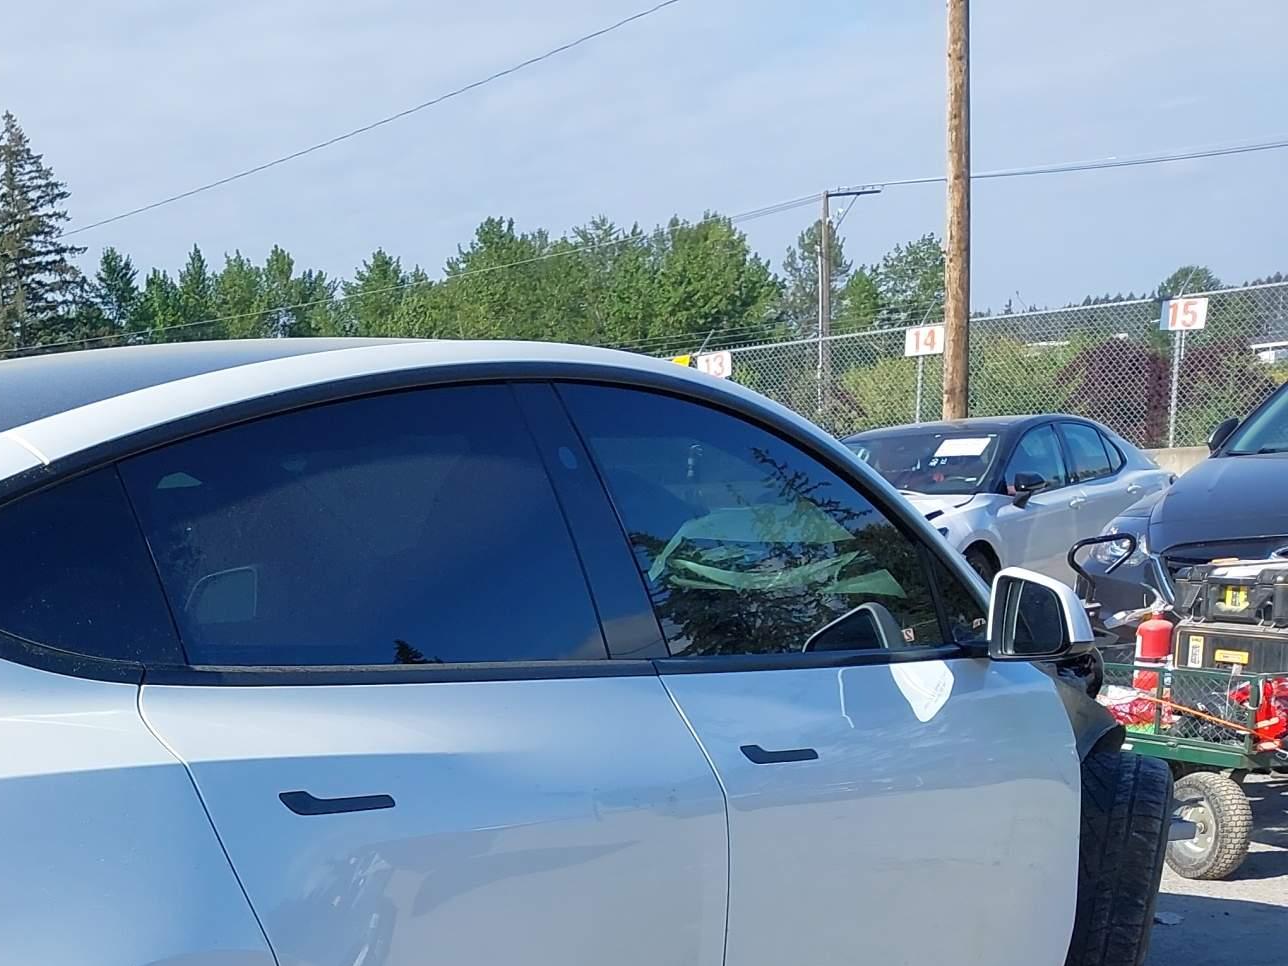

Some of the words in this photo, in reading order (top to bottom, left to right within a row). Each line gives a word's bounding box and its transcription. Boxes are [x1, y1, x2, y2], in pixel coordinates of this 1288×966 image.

[1169, 301, 1198, 328] 15
[913, 329, 936, 352] 14
[705, 354, 725, 376] 13
